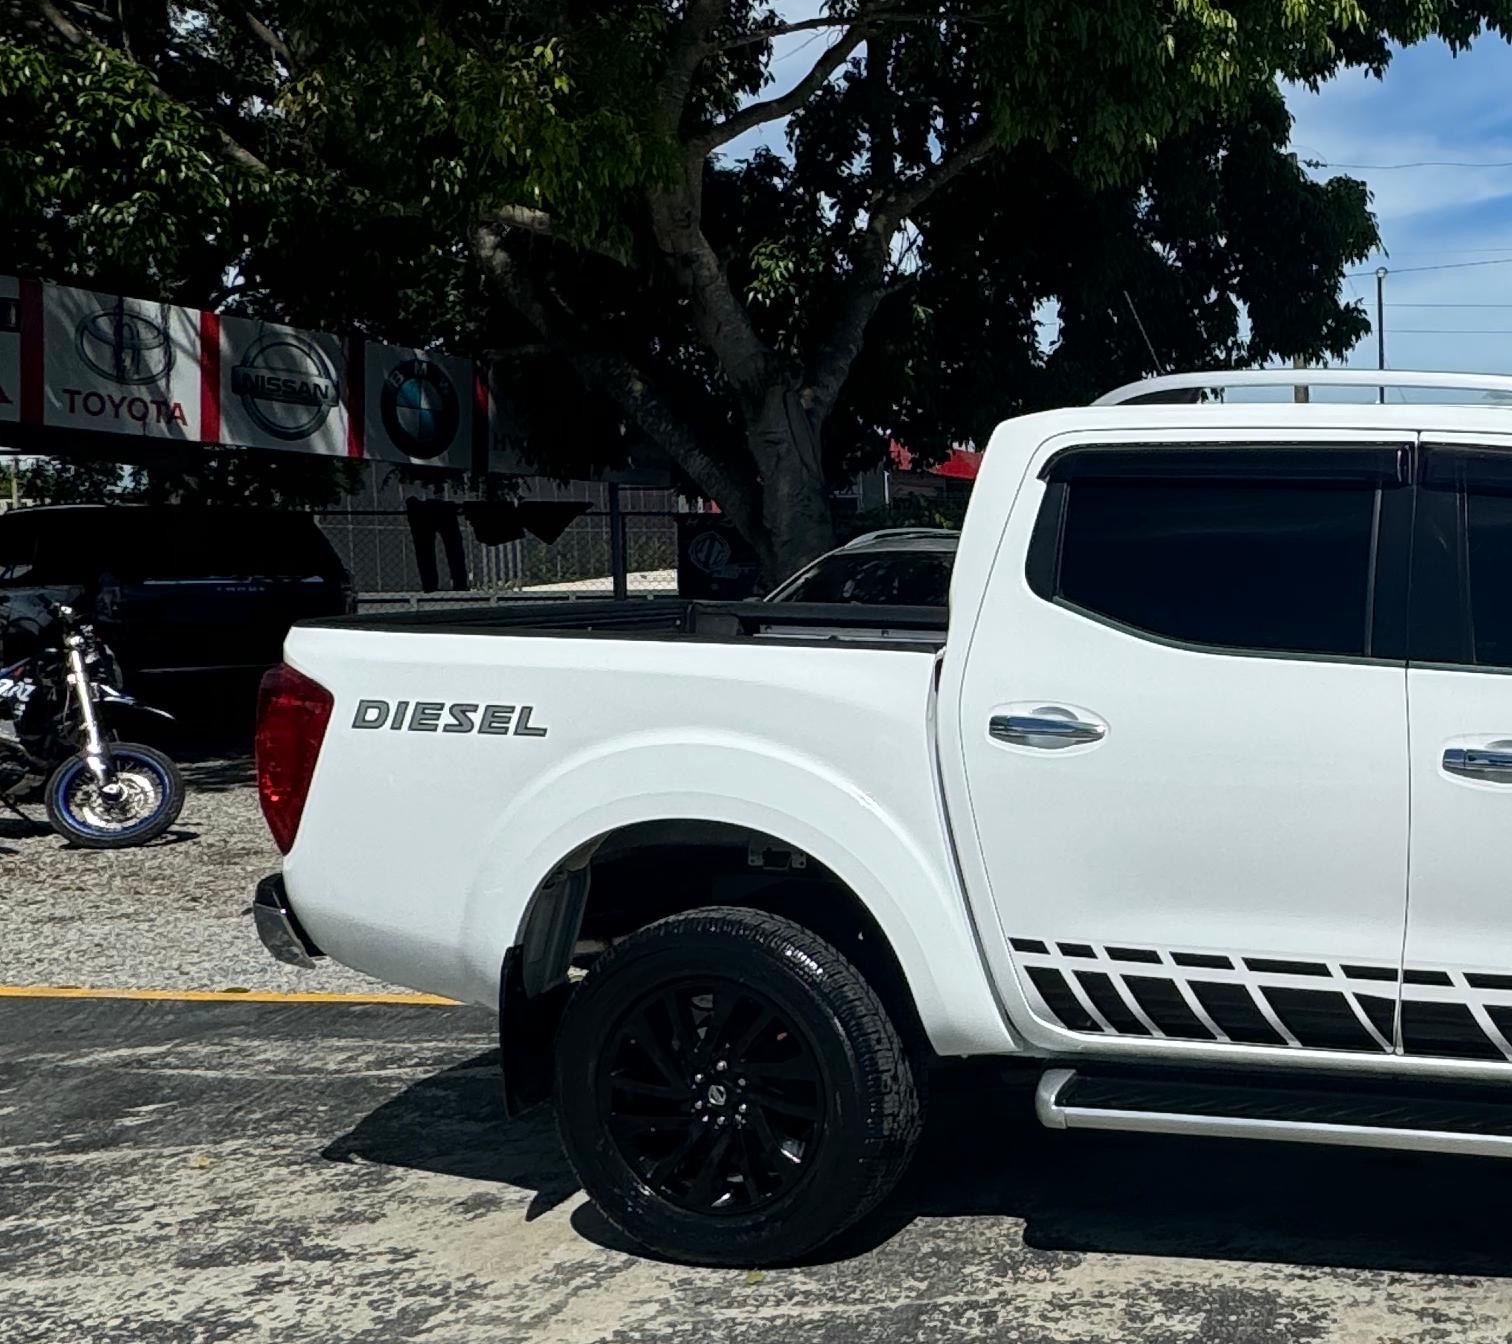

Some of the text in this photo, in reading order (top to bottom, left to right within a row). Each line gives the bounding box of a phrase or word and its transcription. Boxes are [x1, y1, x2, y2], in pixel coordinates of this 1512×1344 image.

[240, 372, 330, 400] NISSAN
[62, 389, 188, 426] TOYOTA
[351, 698, 548, 738] DIESEL
